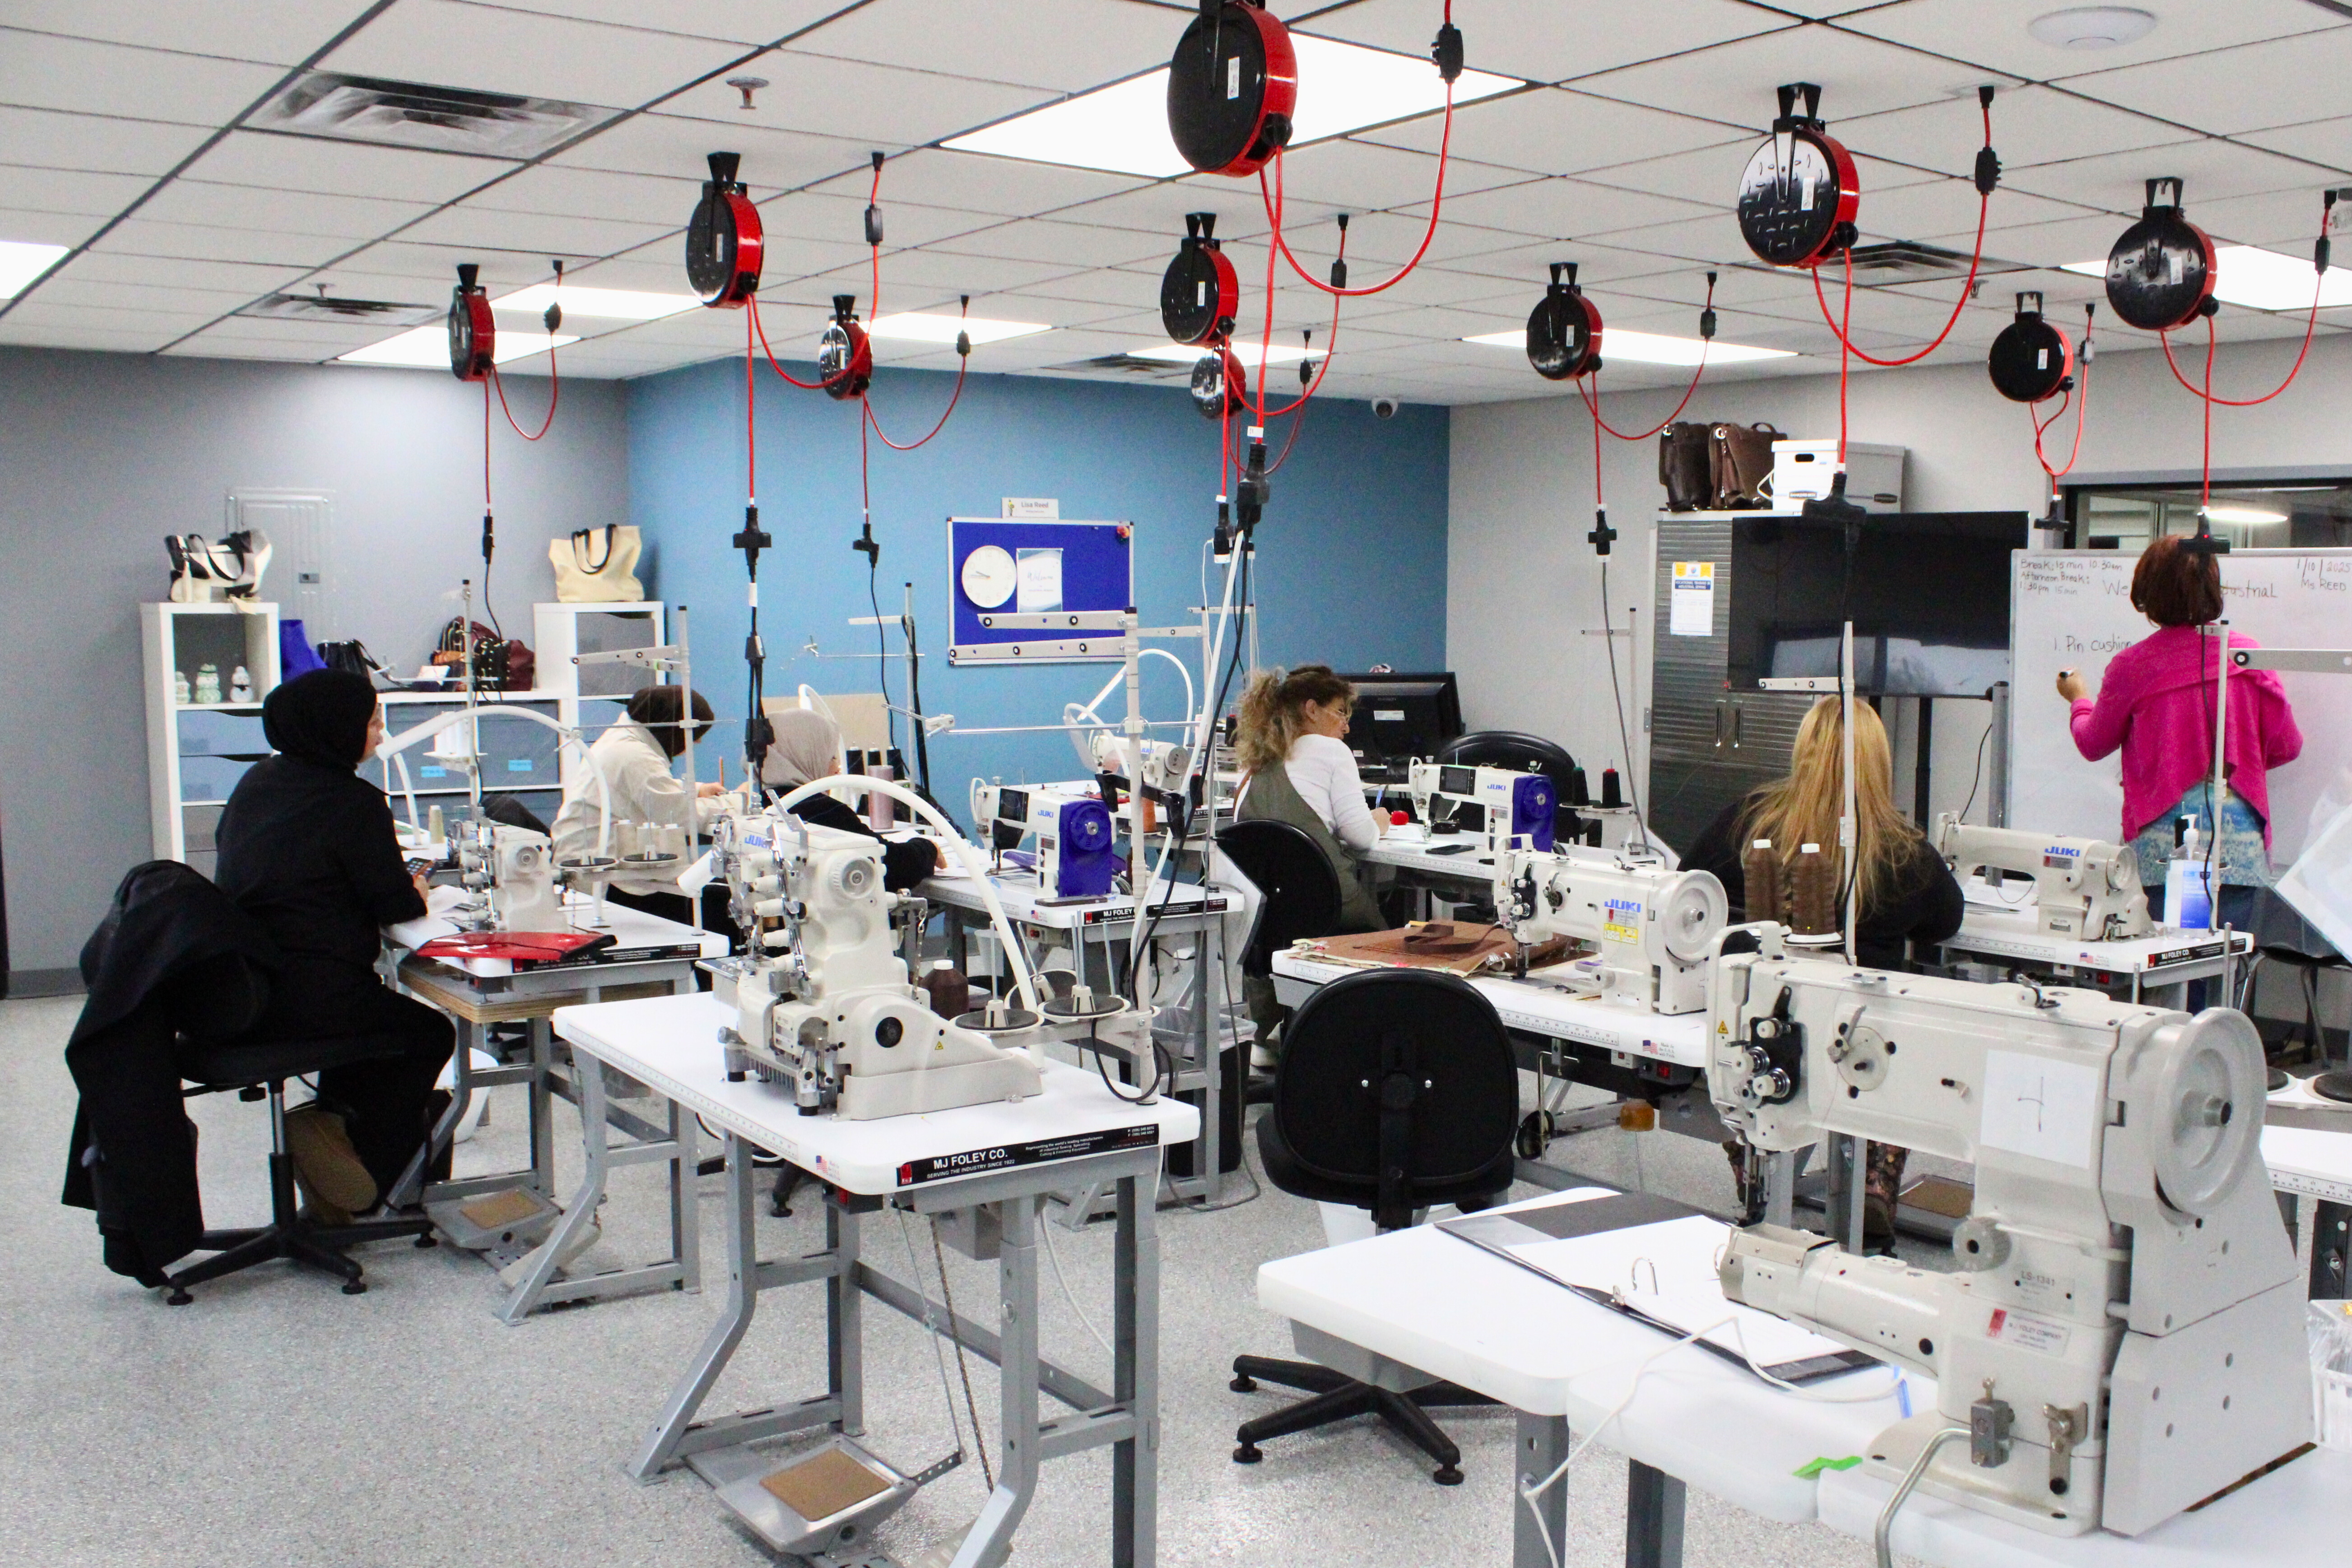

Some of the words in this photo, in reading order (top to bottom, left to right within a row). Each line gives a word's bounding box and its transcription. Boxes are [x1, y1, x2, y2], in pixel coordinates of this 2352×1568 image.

[2066, 561, 2083, 570] min
[2319, 578, 2347, 591] REED
[2065, 636, 2084, 653] Pin
[1037, 810, 1054, 818] JUKI
[2045, 847, 2080, 857] JUKI
[1604, 898, 1641, 913] JUKI
[2168, 950, 2182, 958] FOLEY
[933, 1158, 948, 1170] MJ
[951, 1151, 986, 1167] FOLEY
[989, 1149, 1008, 1159] CO.
[927, 1170, 949, 1179] SERVING
[961, 1164, 986, 1173] INDUSTRY
[2021, 1270, 2055, 1287] LS-1341
